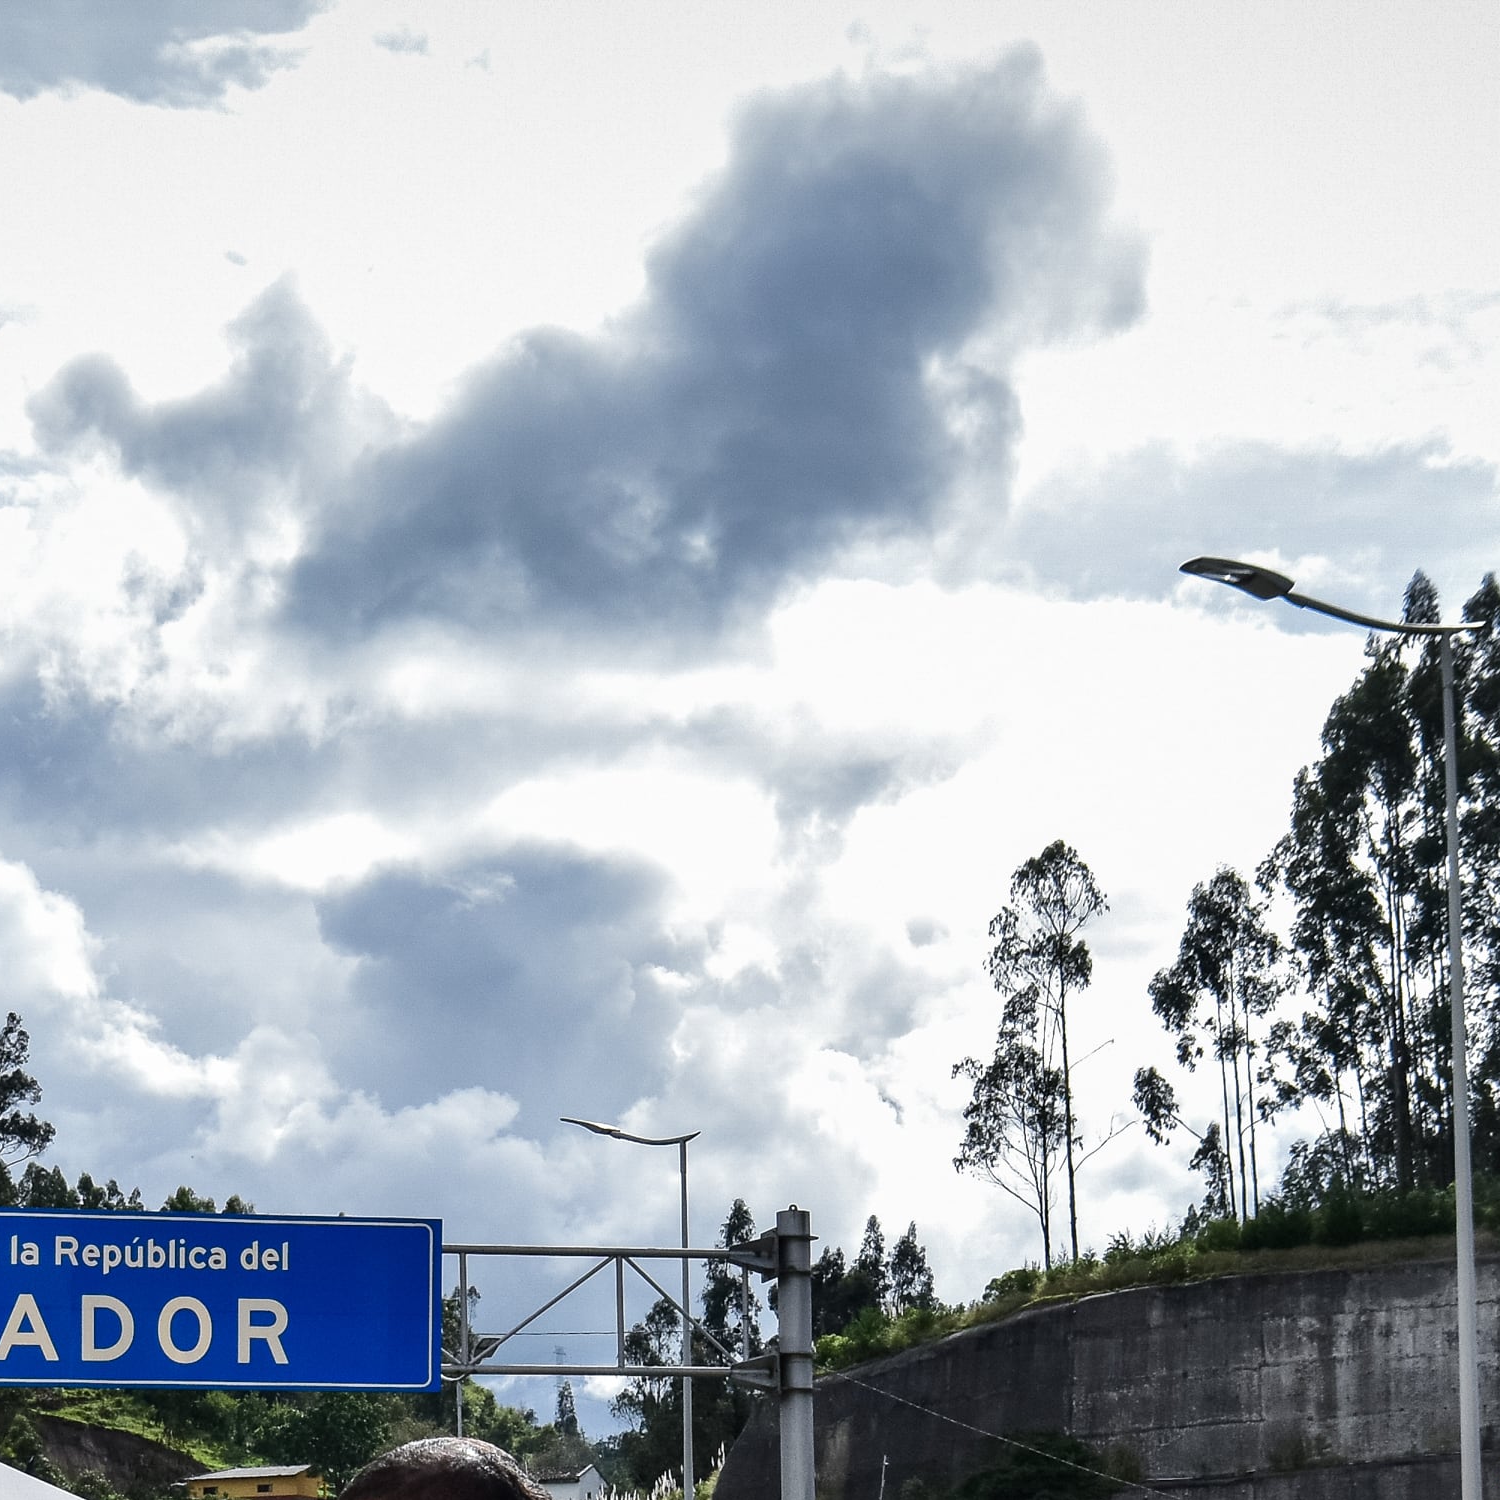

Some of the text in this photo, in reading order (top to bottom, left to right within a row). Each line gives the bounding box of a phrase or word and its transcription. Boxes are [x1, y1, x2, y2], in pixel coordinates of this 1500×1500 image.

[10, 1235, 40, 1266] la
[55, 1236, 227, 1275] República
[240, 1238, 289, 1271] del
